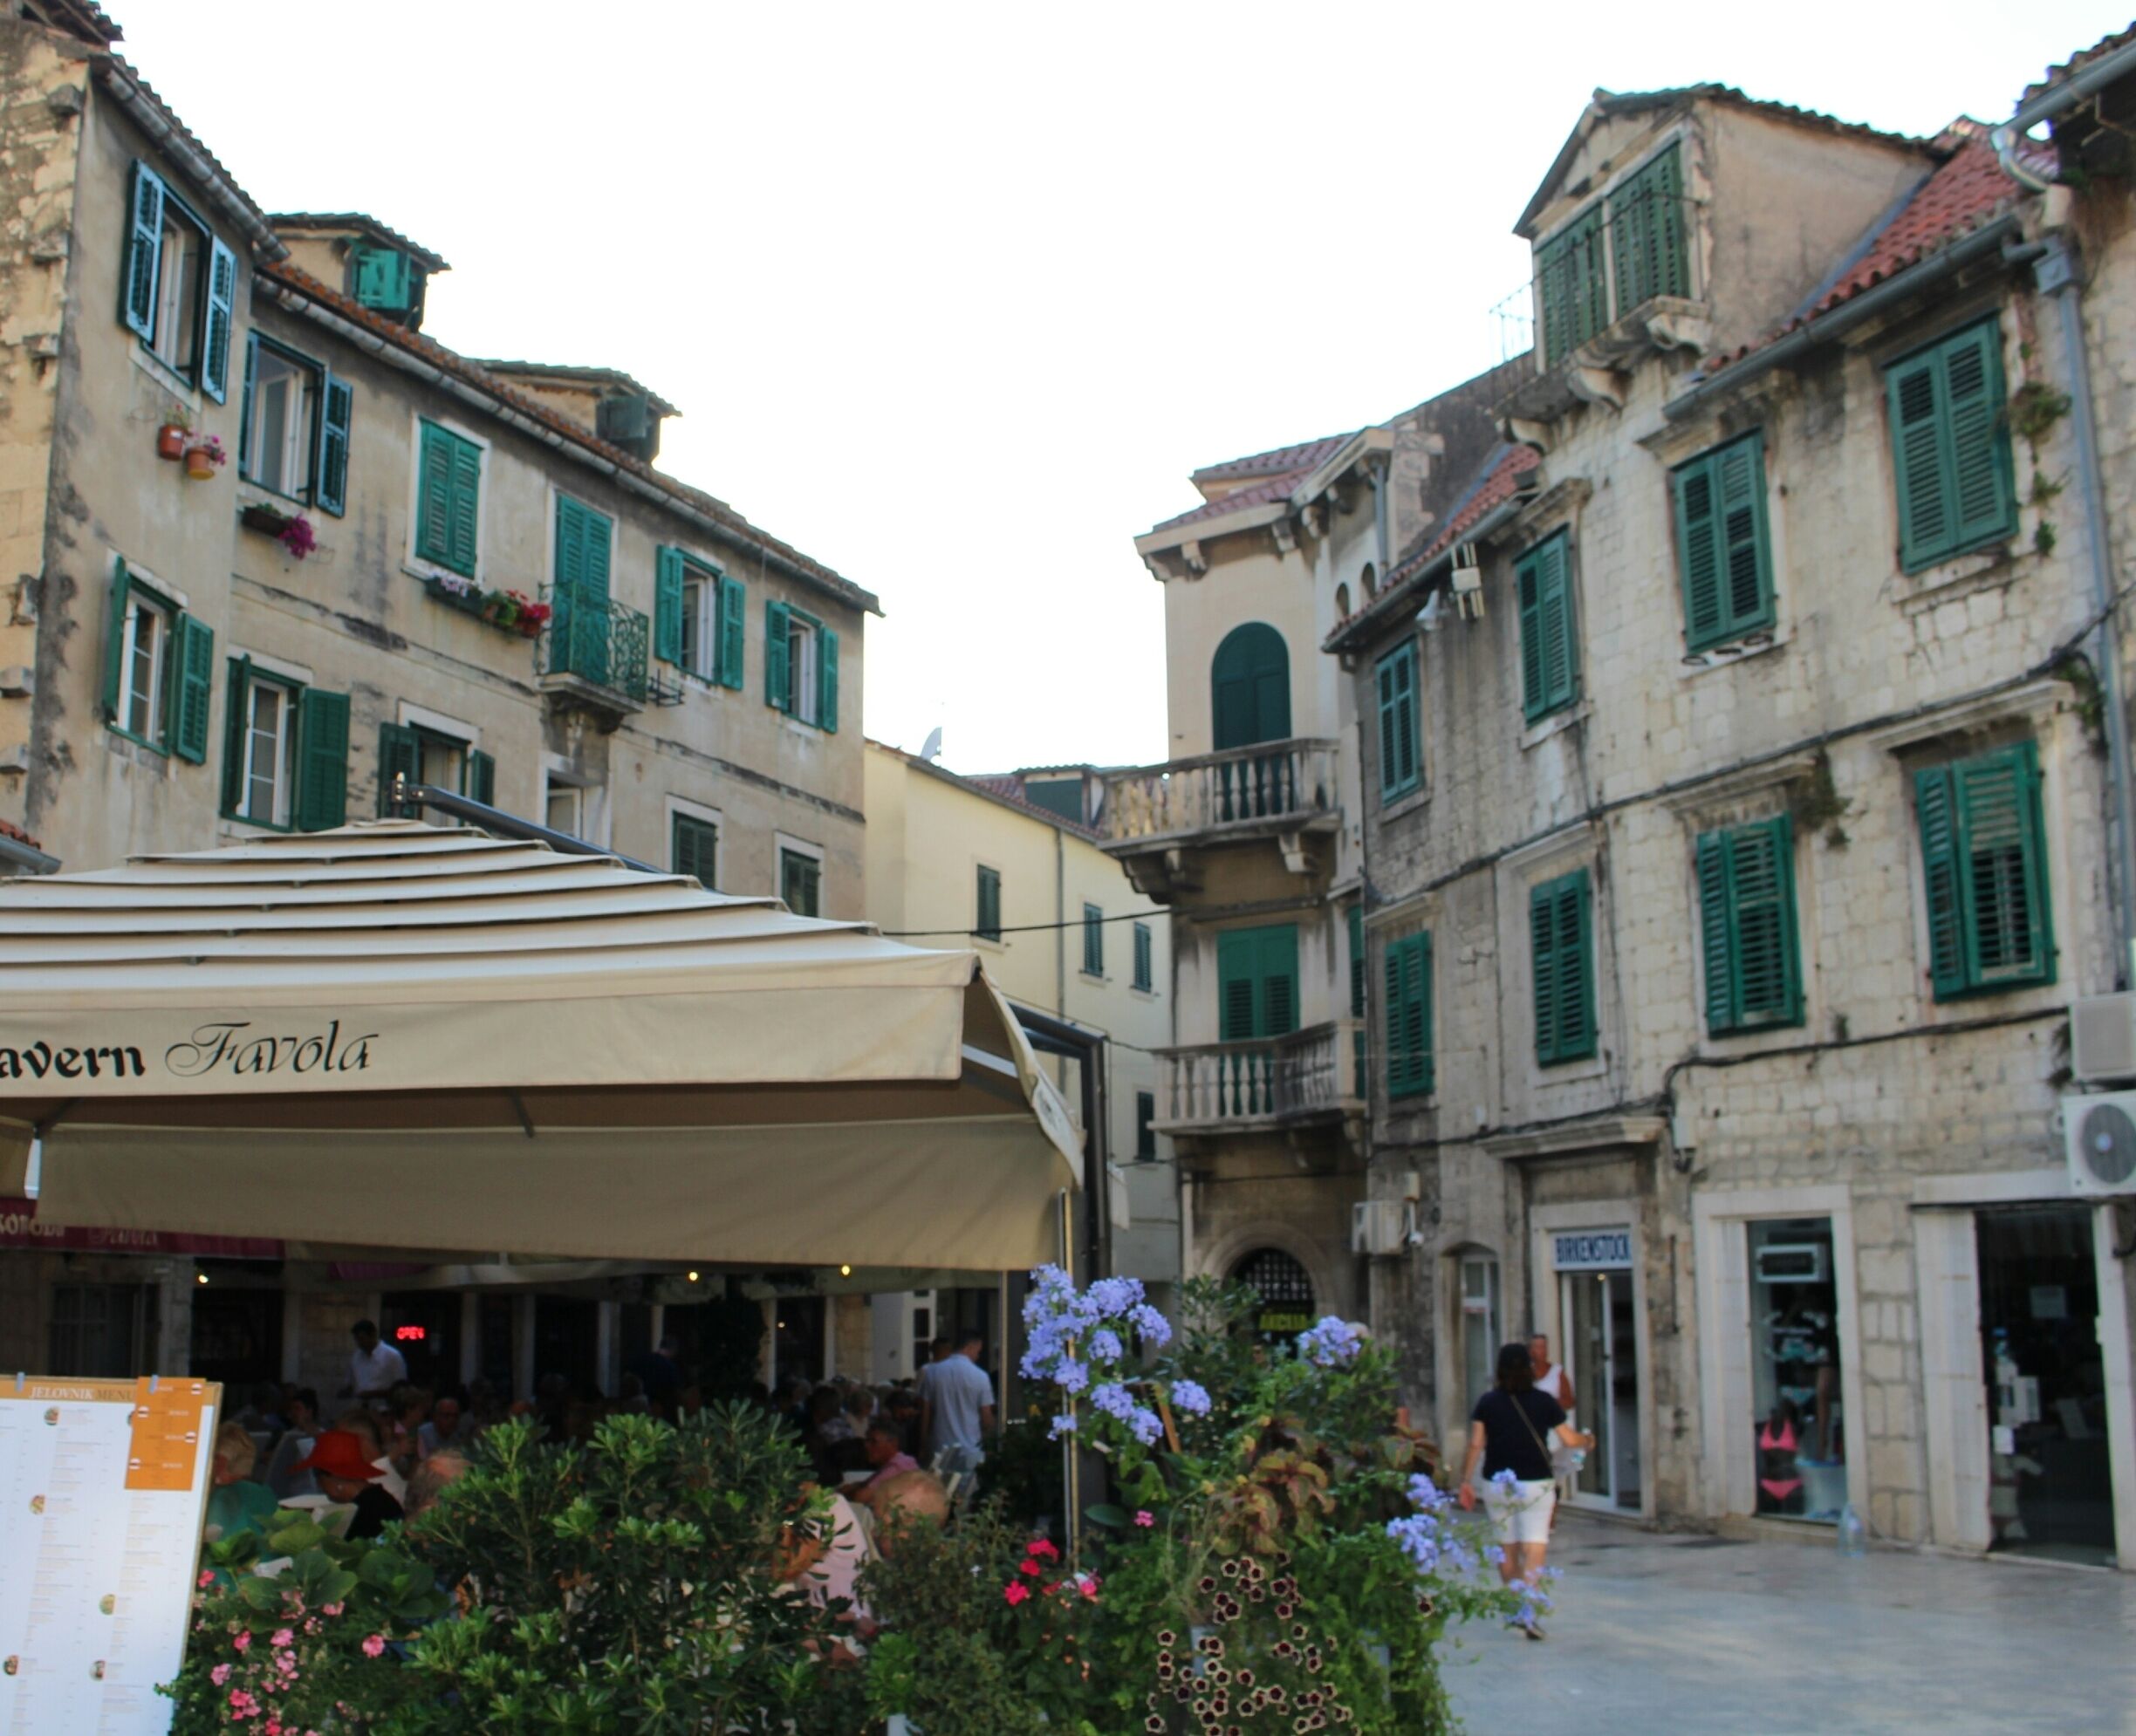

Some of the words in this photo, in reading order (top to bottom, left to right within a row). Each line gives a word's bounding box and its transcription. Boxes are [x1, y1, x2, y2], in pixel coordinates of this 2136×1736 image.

[165, 1020, 379, 1077] Favola
[1555, 1234, 1630, 1263] BIRKENSTOCK
[396, 1326, 426, 1340] OPEN
[31, 1385, 94, 1401] JELOVNIK
